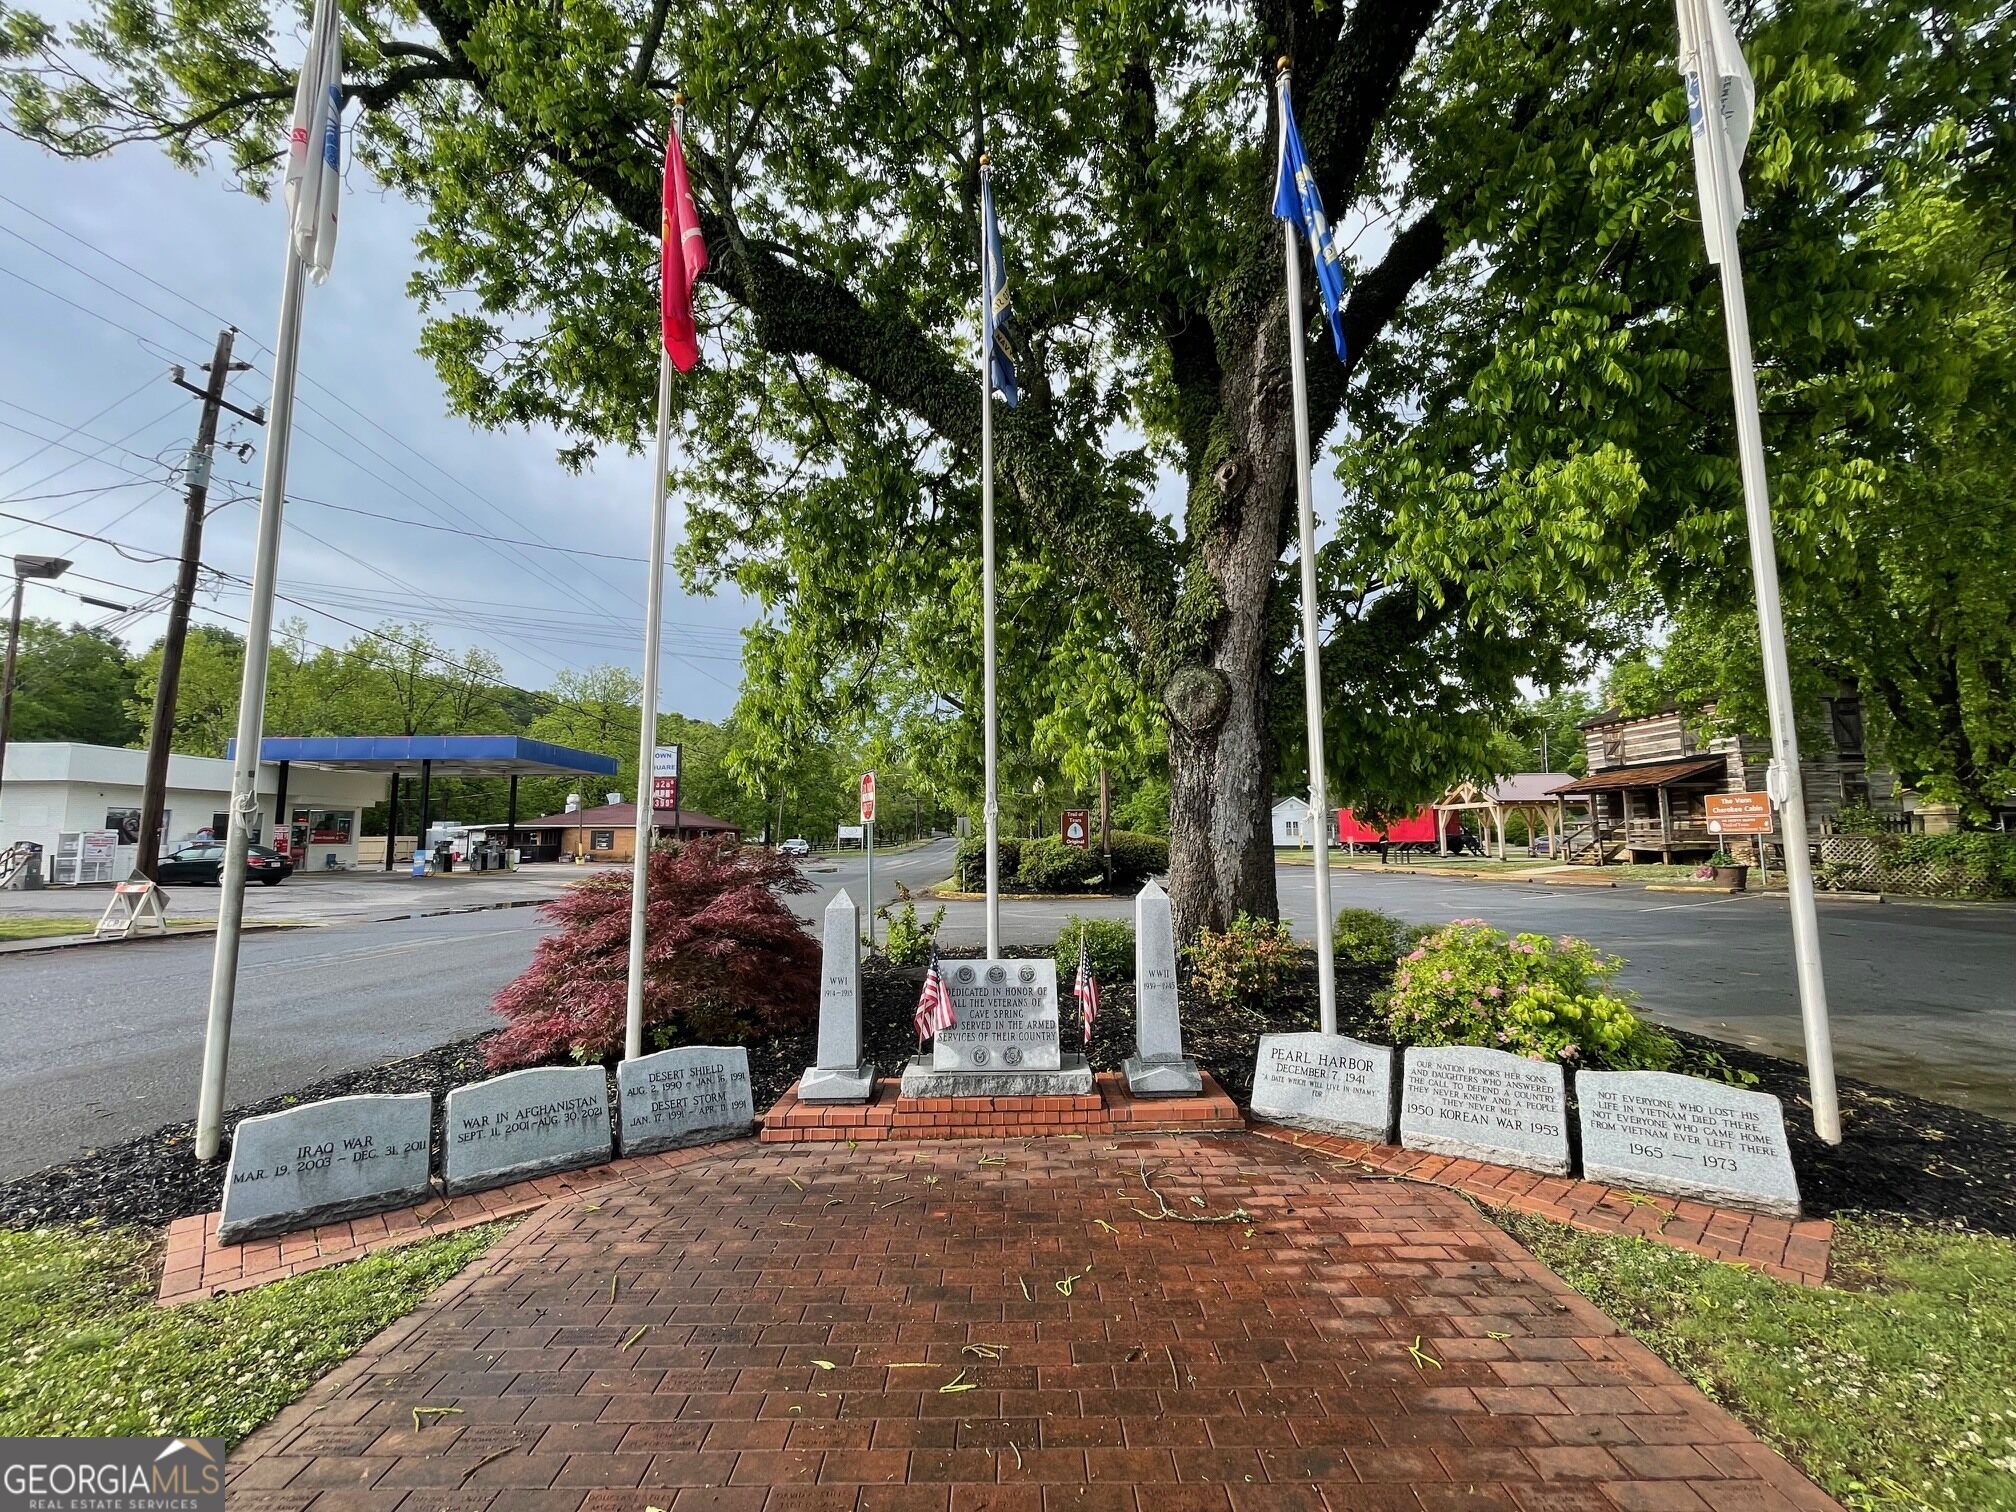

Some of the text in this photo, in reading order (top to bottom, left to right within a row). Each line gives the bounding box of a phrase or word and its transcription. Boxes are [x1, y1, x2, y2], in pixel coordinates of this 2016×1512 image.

[996, 333, 1014, 356] NAVY
[830, 977, 848, 985] WWI
[947, 987, 1047, 996] DEDICATED IN HONOR OF
[952, 998, 1042, 1007] ALL THE VETERANS OF
[970, 1010, 1024, 1018] CAVE SPRING
[938, 1032, 1056, 1041] SERVICES OF THEIR COUNTRY
[962, 1022, 991, 1030] SERVED
[995, 1021, 1004, 1030] IN
[1008, 1021, 1023, 1030] THE
[1027, 1020, 1055, 1029] ARMED
[1271, 1048, 1374, 1072] PEARL HARBOR
[649, 1064, 724, 1082] DESERT SHIELD
[1271, 1074, 1284, 1083] DATE
[1288, 1077, 1306, 1086] WHICH
[1326, 1083, 1340, 1091] LIVE
[1276, 1062, 1326, 1078] DECEMBER
[1345, 1073, 1365, 1084] 1941
[1417, 1061, 1432, 1069] OUR
[1436, 1063, 1465, 1073] NATION
[1468, 1067, 1500, 1077] HONORS
[1526, 1074, 1547, 1083] SONS
[1432, 1071, 1478, 1083] DAUGHTERS
[1482, 1078, 1501, 1086] WHO
[1506, 1082, 1554, 1094] ANSWERED
[627, 1086, 647, 1097] AUG.
[651, 1085, 659, 1093] 2,
[663, 1081, 682, 1091] 1990
[696, 1077, 715, 1087] JAN.
[730, 1072, 745, 1081] 1991
[1408, 1085, 1429, 1094] THEY
[1433, 1088, 1459, 1098] NEVER
[1464, 1093, 1487, 1101] KNEW
[1492, 1097, 1511, 1106] AND
[1428, 1079, 1448, 1088] CALL
[1468, 1085, 1499, 1095] DEFEND
[1514, 1091, 1555, 1103] COUNTRY
[463, 1095, 597, 1129] WAR IN AFGHANISTAN
[630, 1116, 650, 1126] JAN.
[654, 1114, 664, 1122] 17,
[669, 1110, 685, 1120] 1991
[699, 1106, 717, 1115] APR.
[731, 1100, 746, 1109] 1991
[652, 1091, 726, 1112] DESERT STORM
[1442, 1098, 1463, 1108] THEY
[1468, 1102, 1496, 1112] NEVER
[1598, 1091, 1760, 1121] NOT EVERYONE WHO LOST HIS
[457, 1130, 486, 1143] SEPT.
[564, 1112, 580, 1122] 30,
[582, 1107, 602, 1118] 2021
[1407, 1104, 1559, 1136] 1950 KOREAN WAR 1953
[1592, 1110, 1772, 1145] NOT EVERYONE WHO CAME HOME
[1598, 1102, 1762, 1133] LIFE IN VIETNAM DIED THERE,
[1590, 1120, 1616, 1131] FROM
[1621, 1124, 1668, 1140] VIETNAM
[1673, 1133, 1701, 1145] EVER
[1706, 1138, 1732, 1150] LEFT
[297, 1136, 374, 1159] IRAQ WAR
[297, 1157, 331, 1172] 2003
[353, 1149, 379, 1162] DEC.
[404, 1140, 426, 1153] 2011
[1629, 1142, 1663, 1159] 1965
[1702, 1155, 1738, 1172] 1973
